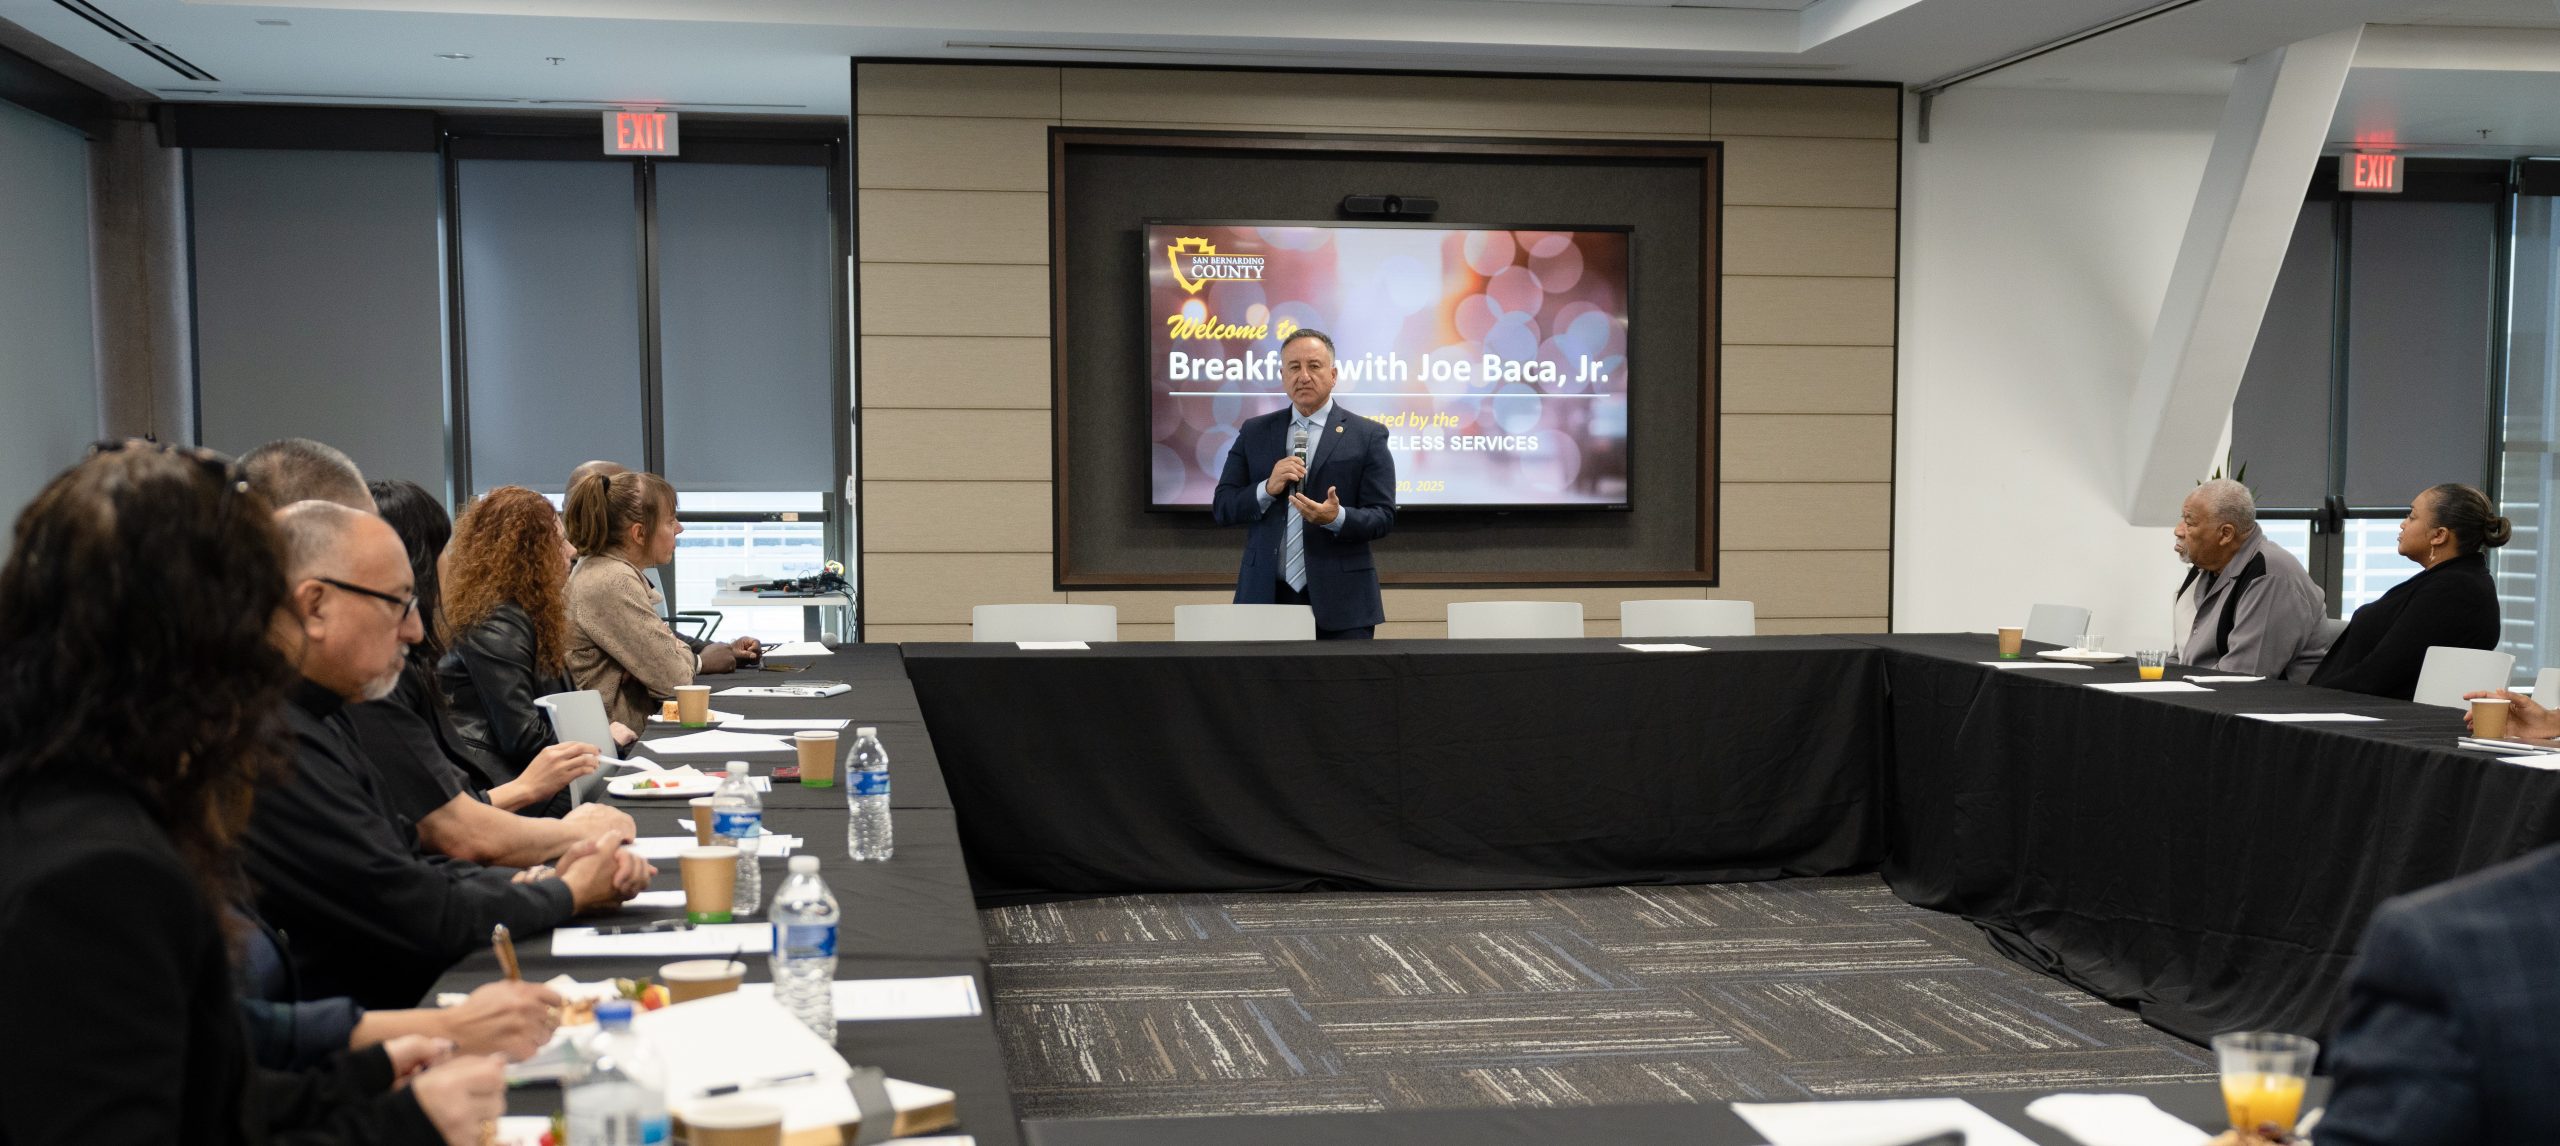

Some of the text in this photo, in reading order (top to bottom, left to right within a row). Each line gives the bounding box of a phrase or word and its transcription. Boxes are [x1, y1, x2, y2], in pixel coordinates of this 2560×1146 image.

[617, 112, 667, 151] EXIT
[2354, 154, 2396, 188] EXIT
[1192, 256, 1264, 265] SAN BERNARDINO
[1191, 265, 1264, 278] COUNTY
[1167, 314, 1268, 340] Welcome
[1169, 351, 1609, 387] Breakf with Joe Baca, Jr.
[1409, 411, 1429, 430] by
[1433, 411, 1459, 427] the
[1387, 435, 1539, 451] ELESS SERVICES
[1416, 481, 1445, 491] 2025
